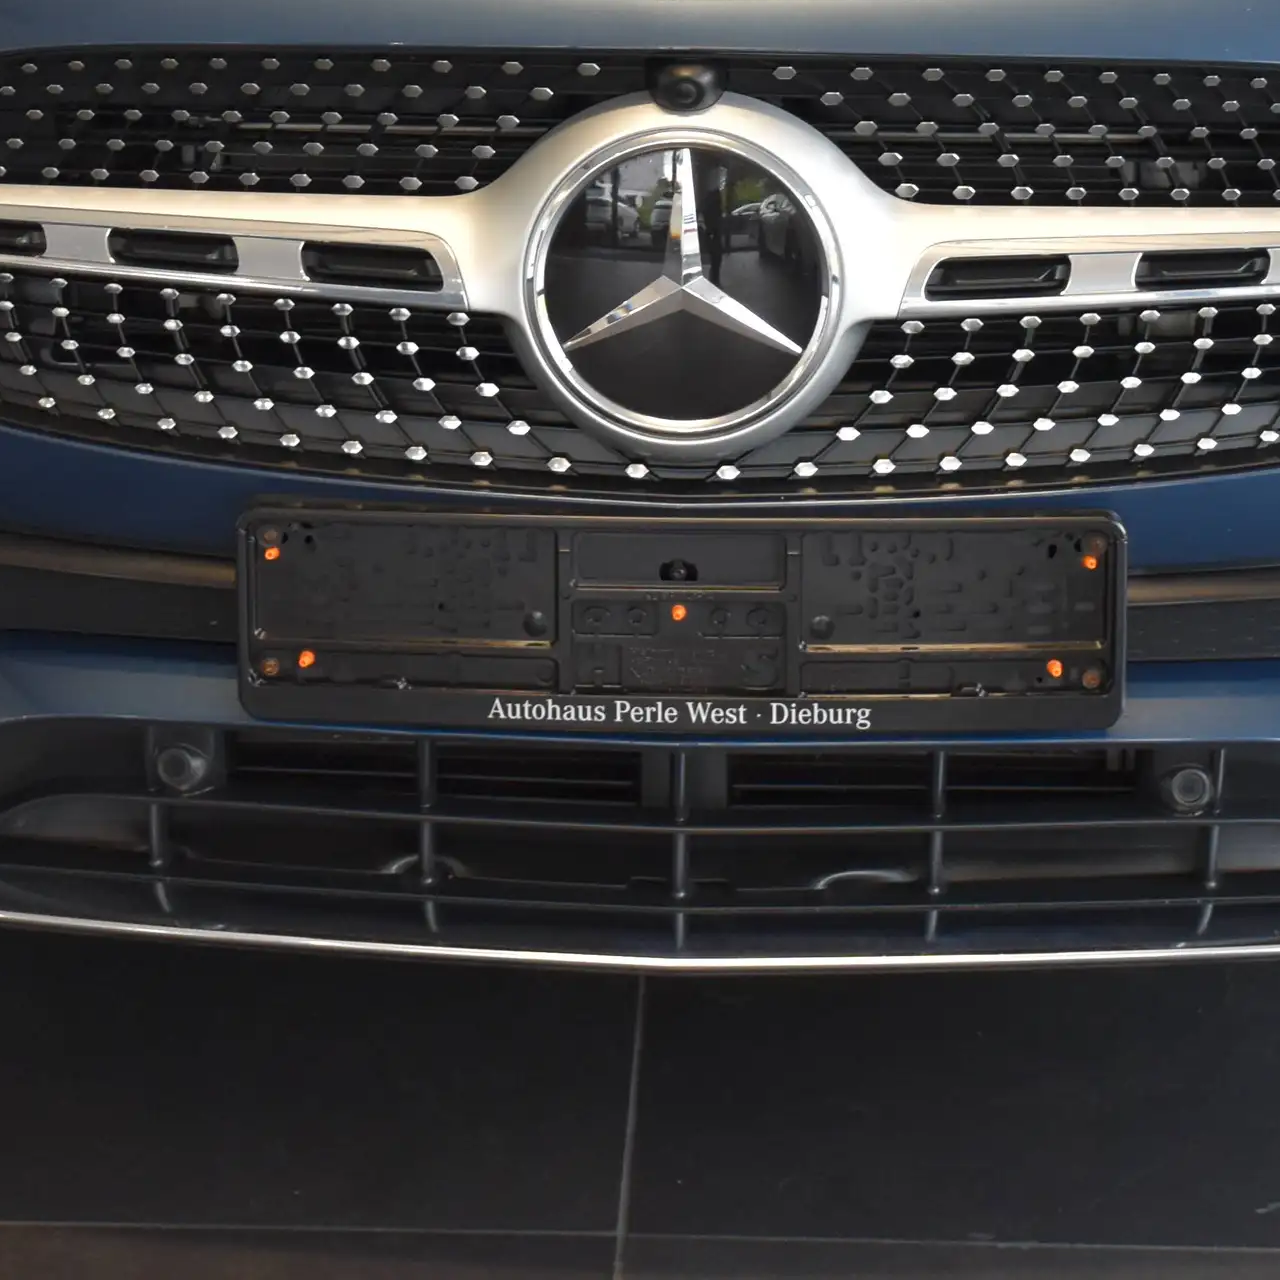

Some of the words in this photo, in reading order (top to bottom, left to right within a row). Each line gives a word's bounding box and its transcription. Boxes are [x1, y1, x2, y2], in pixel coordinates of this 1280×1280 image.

[487, 697, 607, 722] Autohaus
[613, 700, 679, 724] Perle
[685, 701, 748, 725] West
[769, 702, 872, 730] Dieburg
